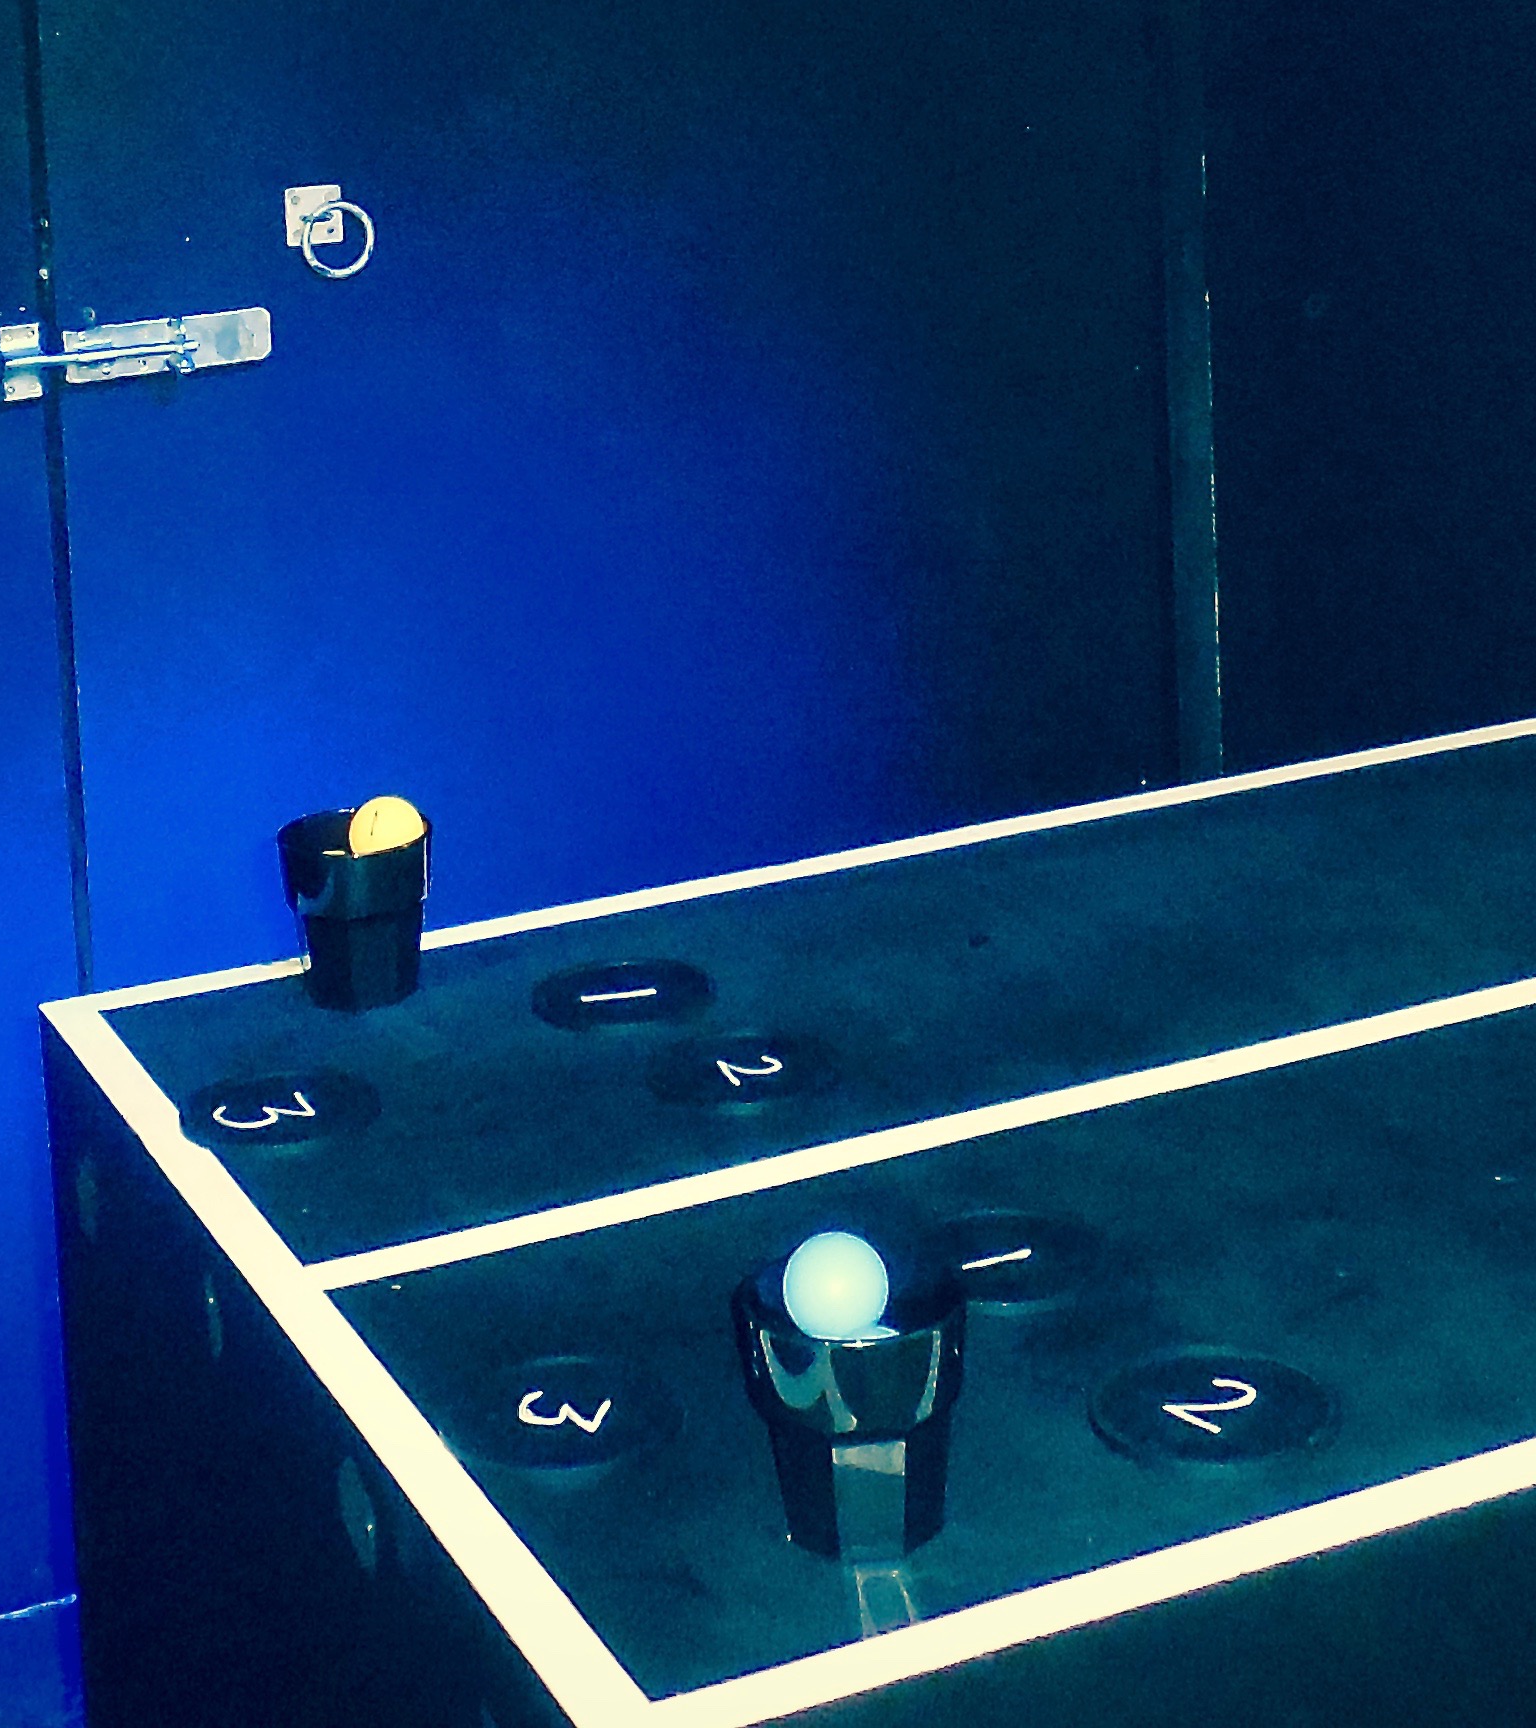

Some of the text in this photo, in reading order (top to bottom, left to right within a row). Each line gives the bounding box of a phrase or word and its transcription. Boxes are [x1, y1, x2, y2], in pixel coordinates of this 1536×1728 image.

[716, 1056, 783, 1087] 2
[212, 1091, 316, 1129] 3
[518, 1390, 612, 1434] 3
[1161, 1377, 1257, 1434] 2
